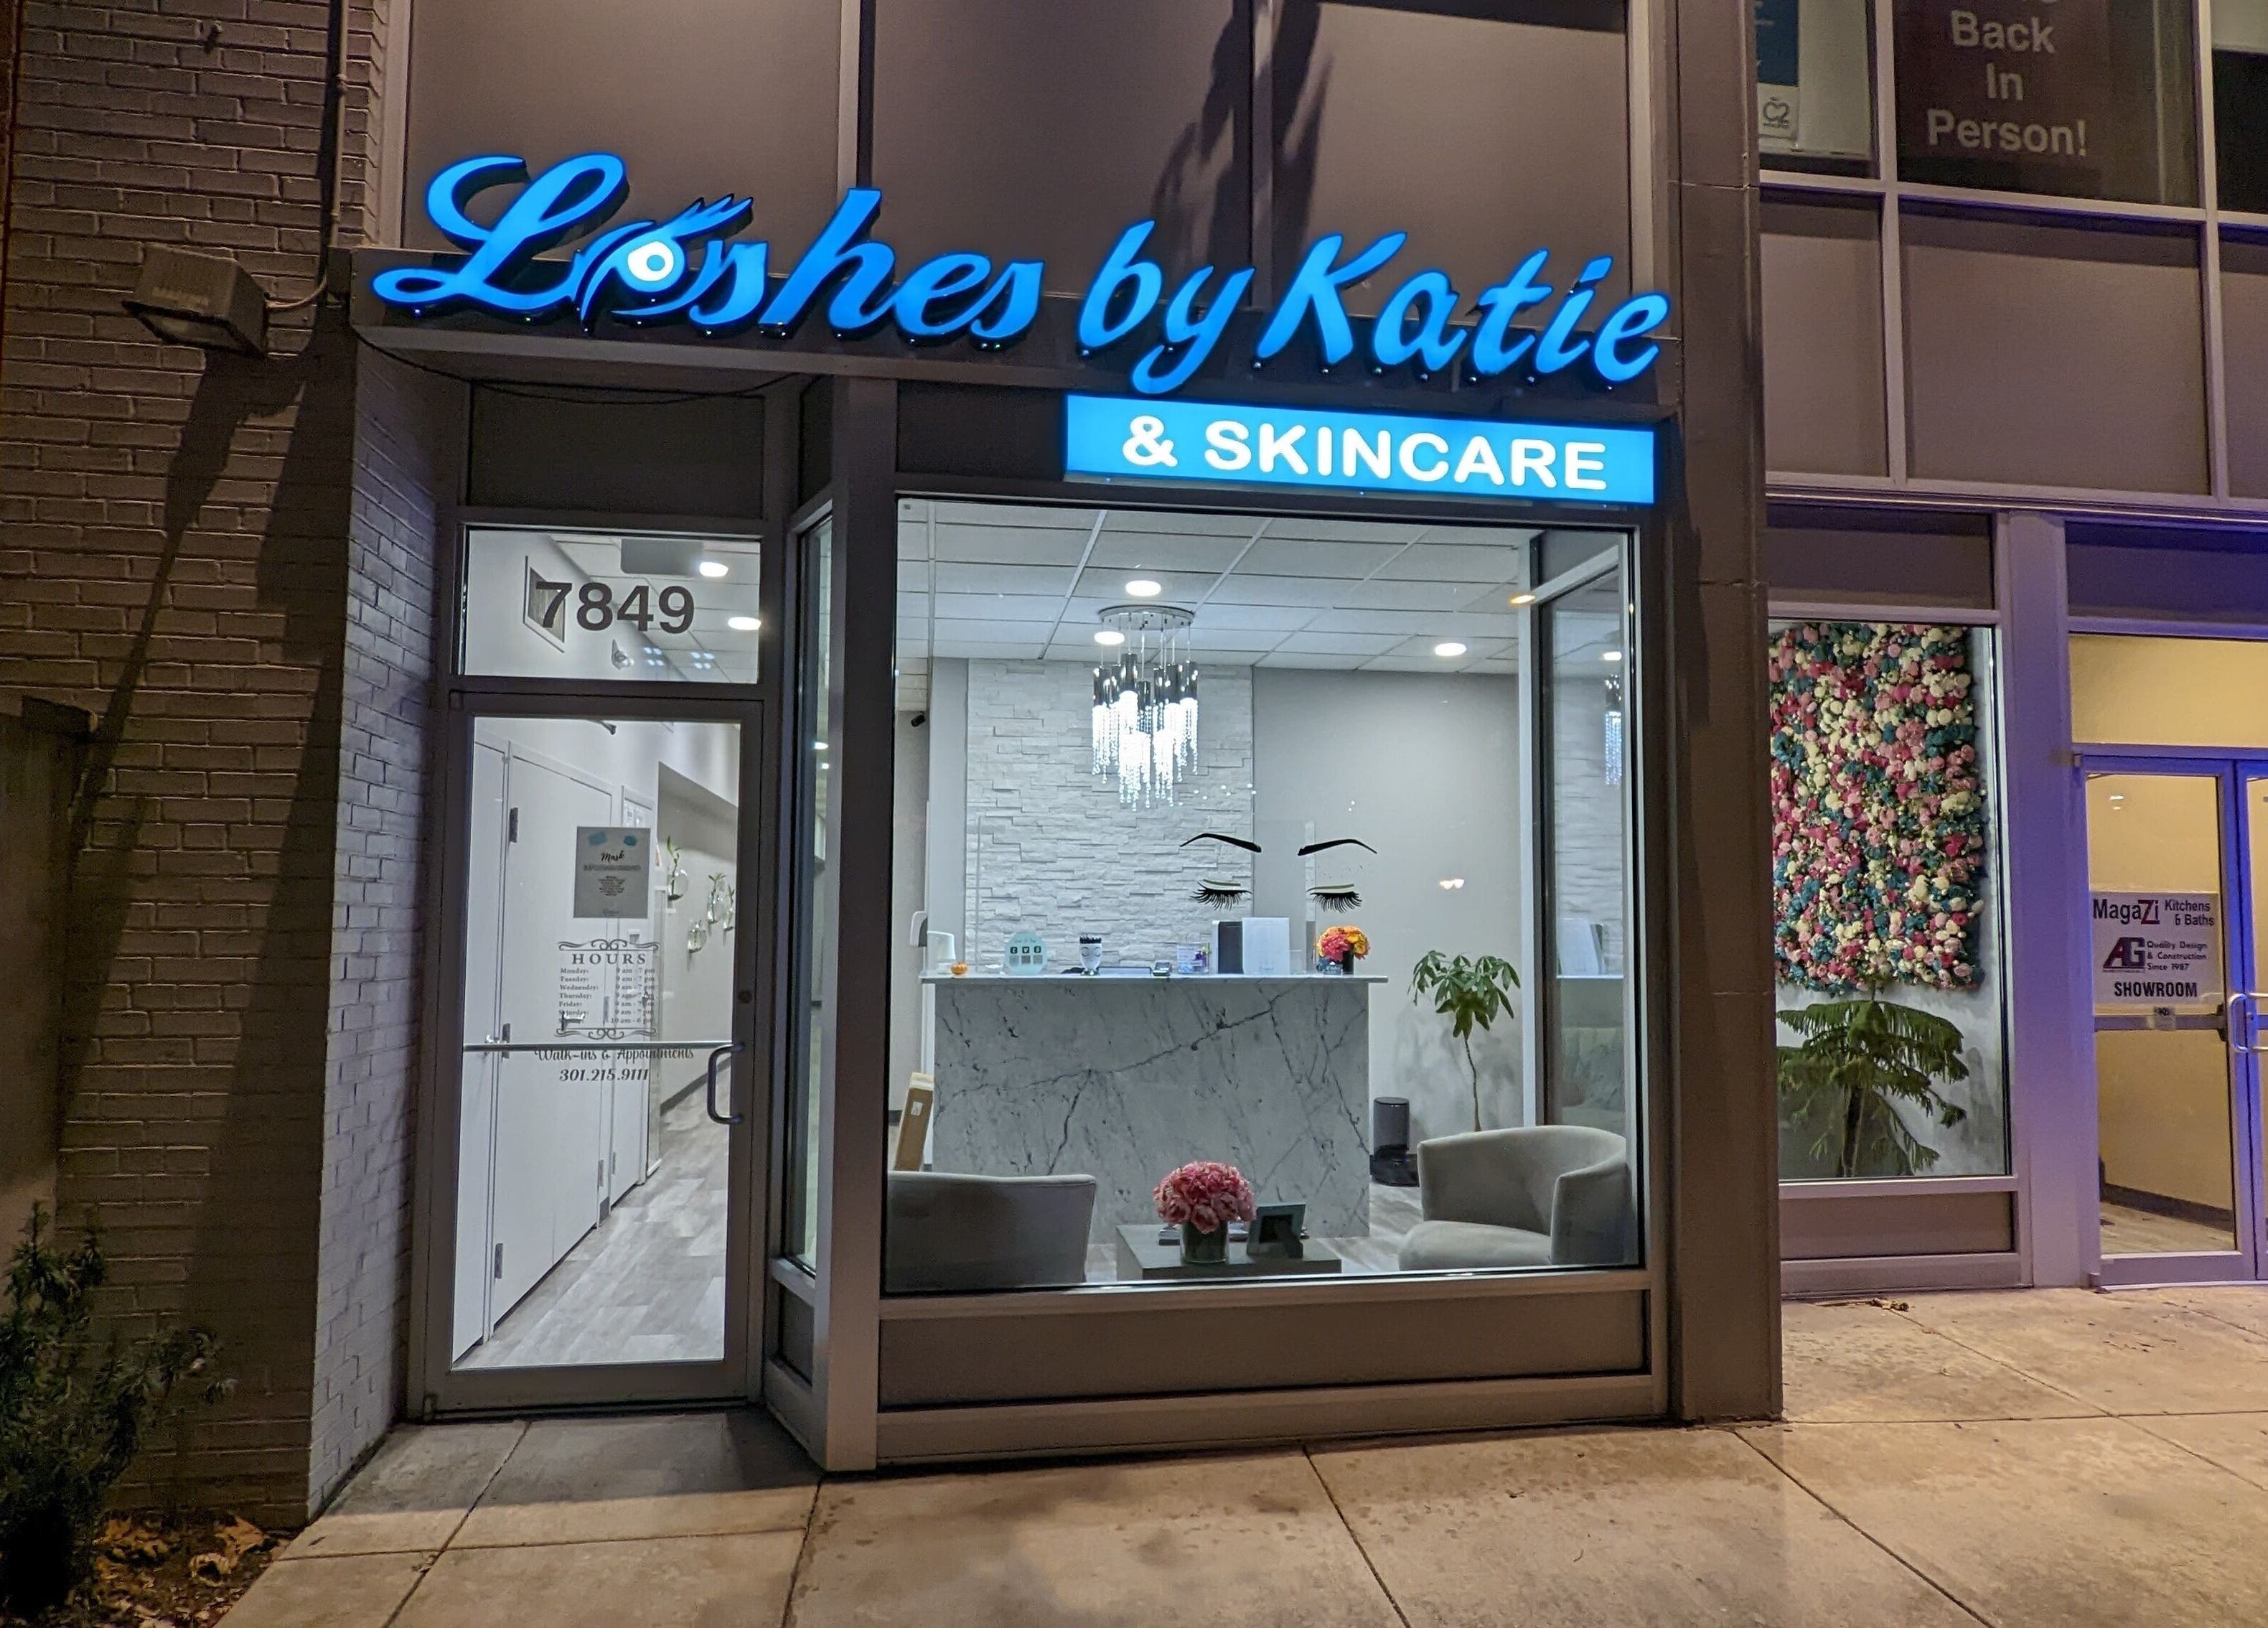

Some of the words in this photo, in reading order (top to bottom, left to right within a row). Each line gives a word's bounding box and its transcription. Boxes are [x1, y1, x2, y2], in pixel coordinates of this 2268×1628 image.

[1951, 9, 2056, 54] Back
[1986, 62, 2024, 100] In
[1927, 108, 2087, 156] Person!
[1077, 220, 1256, 395] by
[1255, 230, 1672, 383] Katie
[1121, 415, 1178, 468] &
[1204, 419, 1608, 491] SKINCARE
[535, 581, 695, 635] 7849
[2093, 898, 2160, 925] MagaZi
[2165, 899, 2211, 912] Kitchens
[2184, 914, 2215, 927] Baths
[572, 953, 647, 965] HOURS
[2157, 951, 2207, 960] Construction
[2114, 981, 2197, 997] SHOWROOM
[559, 1068, 650, 1082] 301.215.9111
